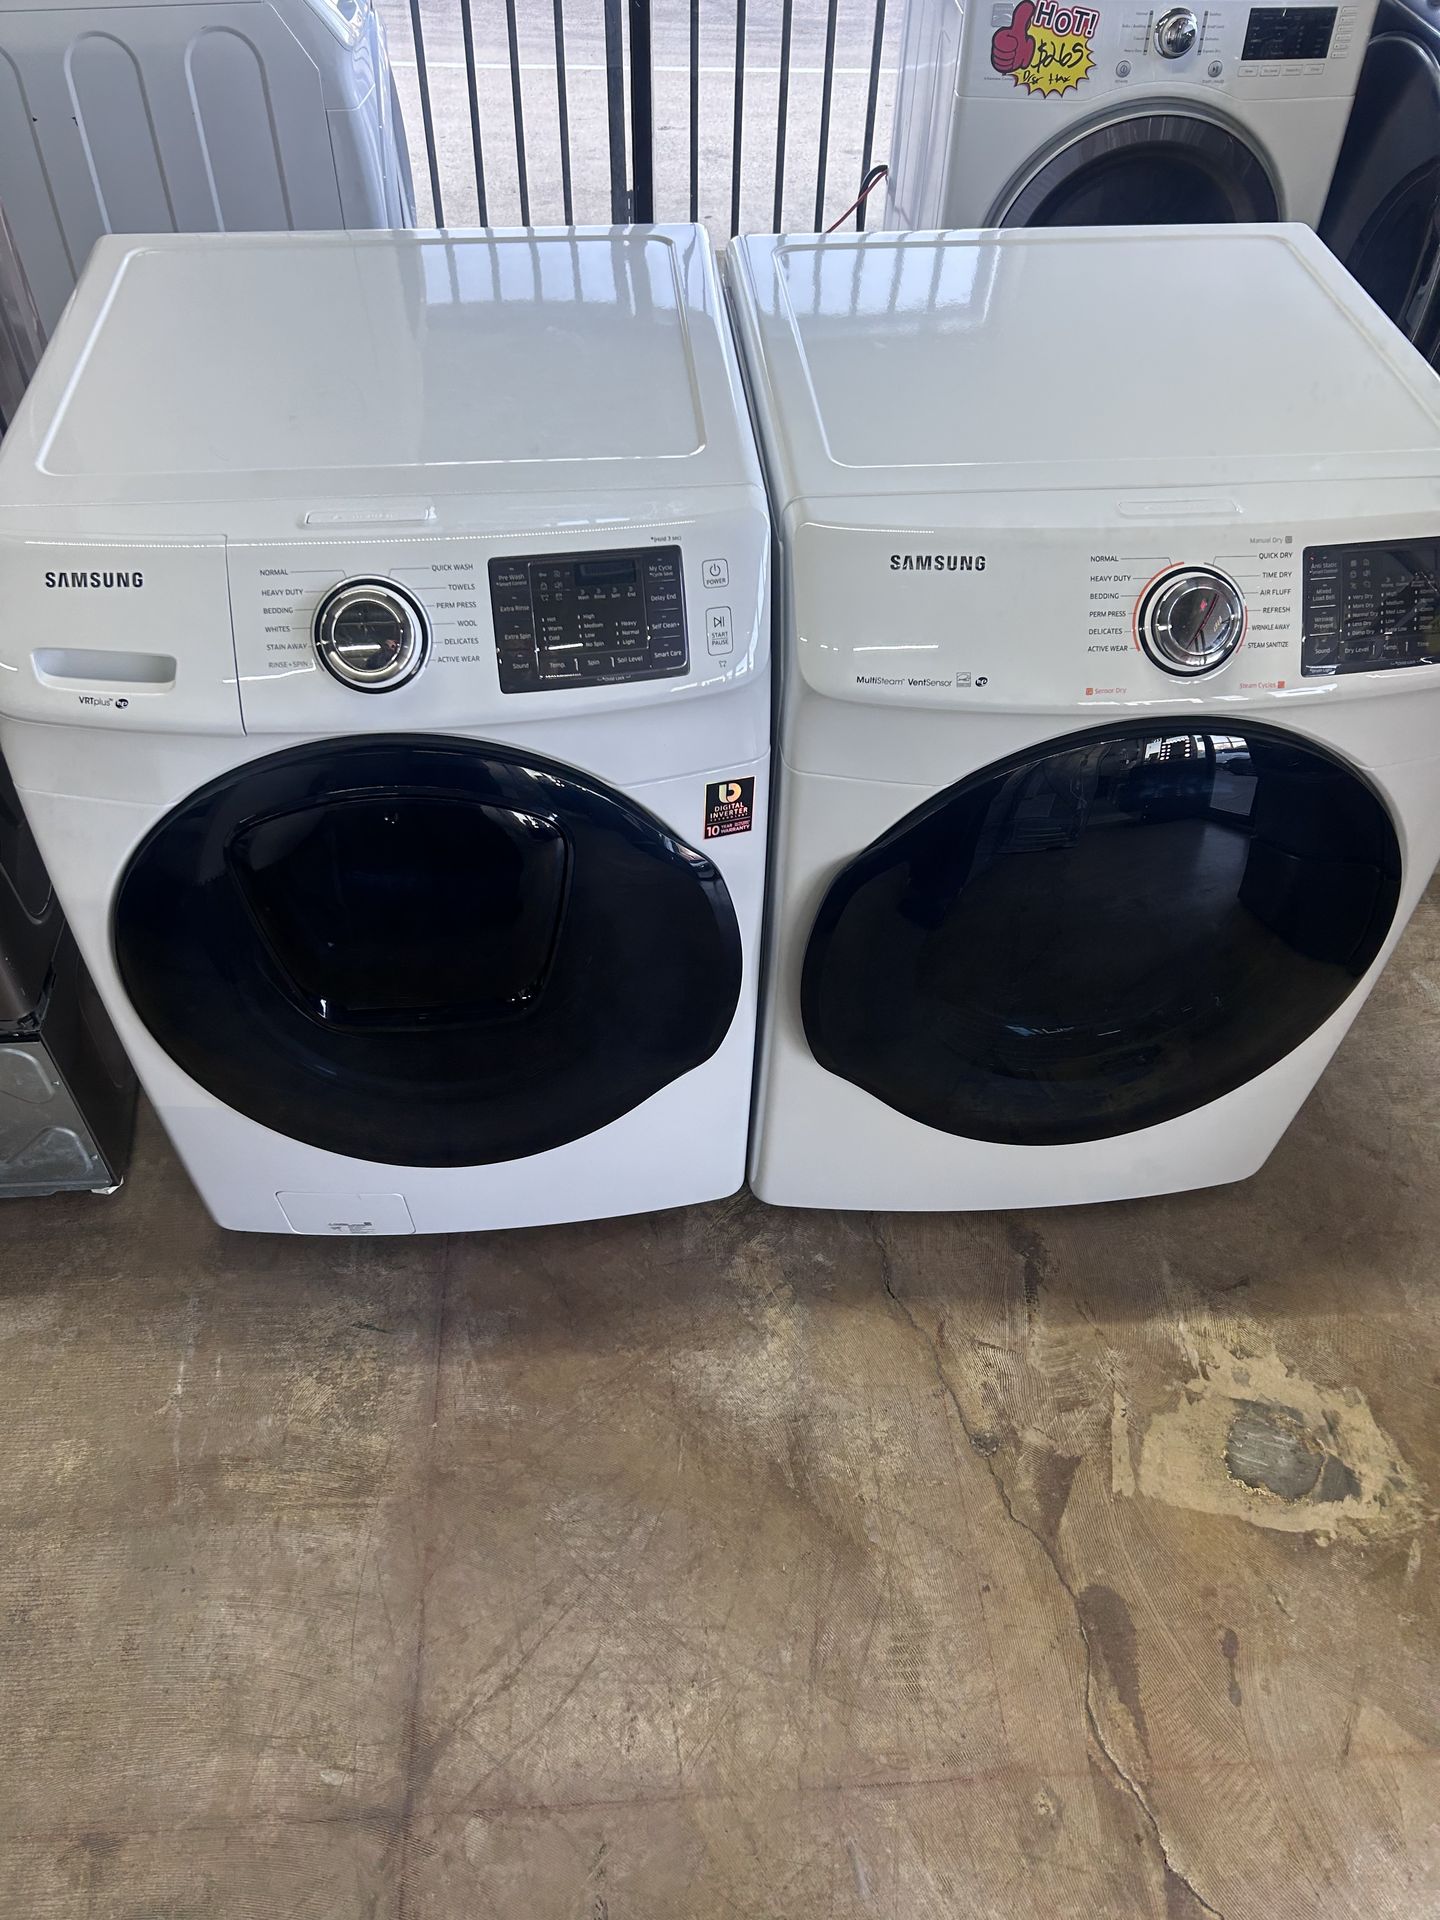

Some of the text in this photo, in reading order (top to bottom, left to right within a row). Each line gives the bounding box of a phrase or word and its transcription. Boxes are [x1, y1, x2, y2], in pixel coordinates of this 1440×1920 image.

[1034, 1, 1098, 37] HOT!
[1031, 39, 1083, 73] $265
[1272, 536, 1283, 544] Dry
[1258, 551, 1293, 560] QUICK DRY
[890, 554, 986, 571] SAMSUNG
[453, 563, 474, 571] WASH
[259, 568, 289, 576] NORMAL
[1262, 571, 1279, 579] TIME
[45, 571, 143, 588] SAMSUNG
[1113, 574, 1131, 582] DUTY
[448, 583, 476, 591] TOWELS
[261, 588, 304, 597] HEAVY DUTY
[1089, 592, 1120, 600] BEDDING
[1271, 588, 1292, 596] FLUFF
[456, 601, 477, 609] PRESS
[499, 605, 514, 613] Extra
[262, 607, 294, 615] BEDDING
[1262, 606, 1291, 614] REFRESH
[456, 619, 478, 627] WOOL
[264, 625, 291, 633] WHITES
[444, 637, 480, 645] DELICATES
[504, 633, 532, 641] Extra Spin
[266, 643, 286, 651] STAIN
[1266, 641, 1289, 649] SANITIZE
[654, 651, 669, 659] Smart
[1314, 647, 1331, 655] Sound
[437, 655, 460, 663] ACTIVE
[292, 660, 309, 668] SPIN
[907, 678, 953, 687] VentSensor
[1239, 681, 1276, 690] Steam Cycles
[1094, 687, 1114, 695] Sensor
[714, 801, 745, 813] DIGITAL
[709, 806, 748, 820] INVERTER
[706, 825, 720, 837] 10
[720, 824, 750, 834] WARRANTY
